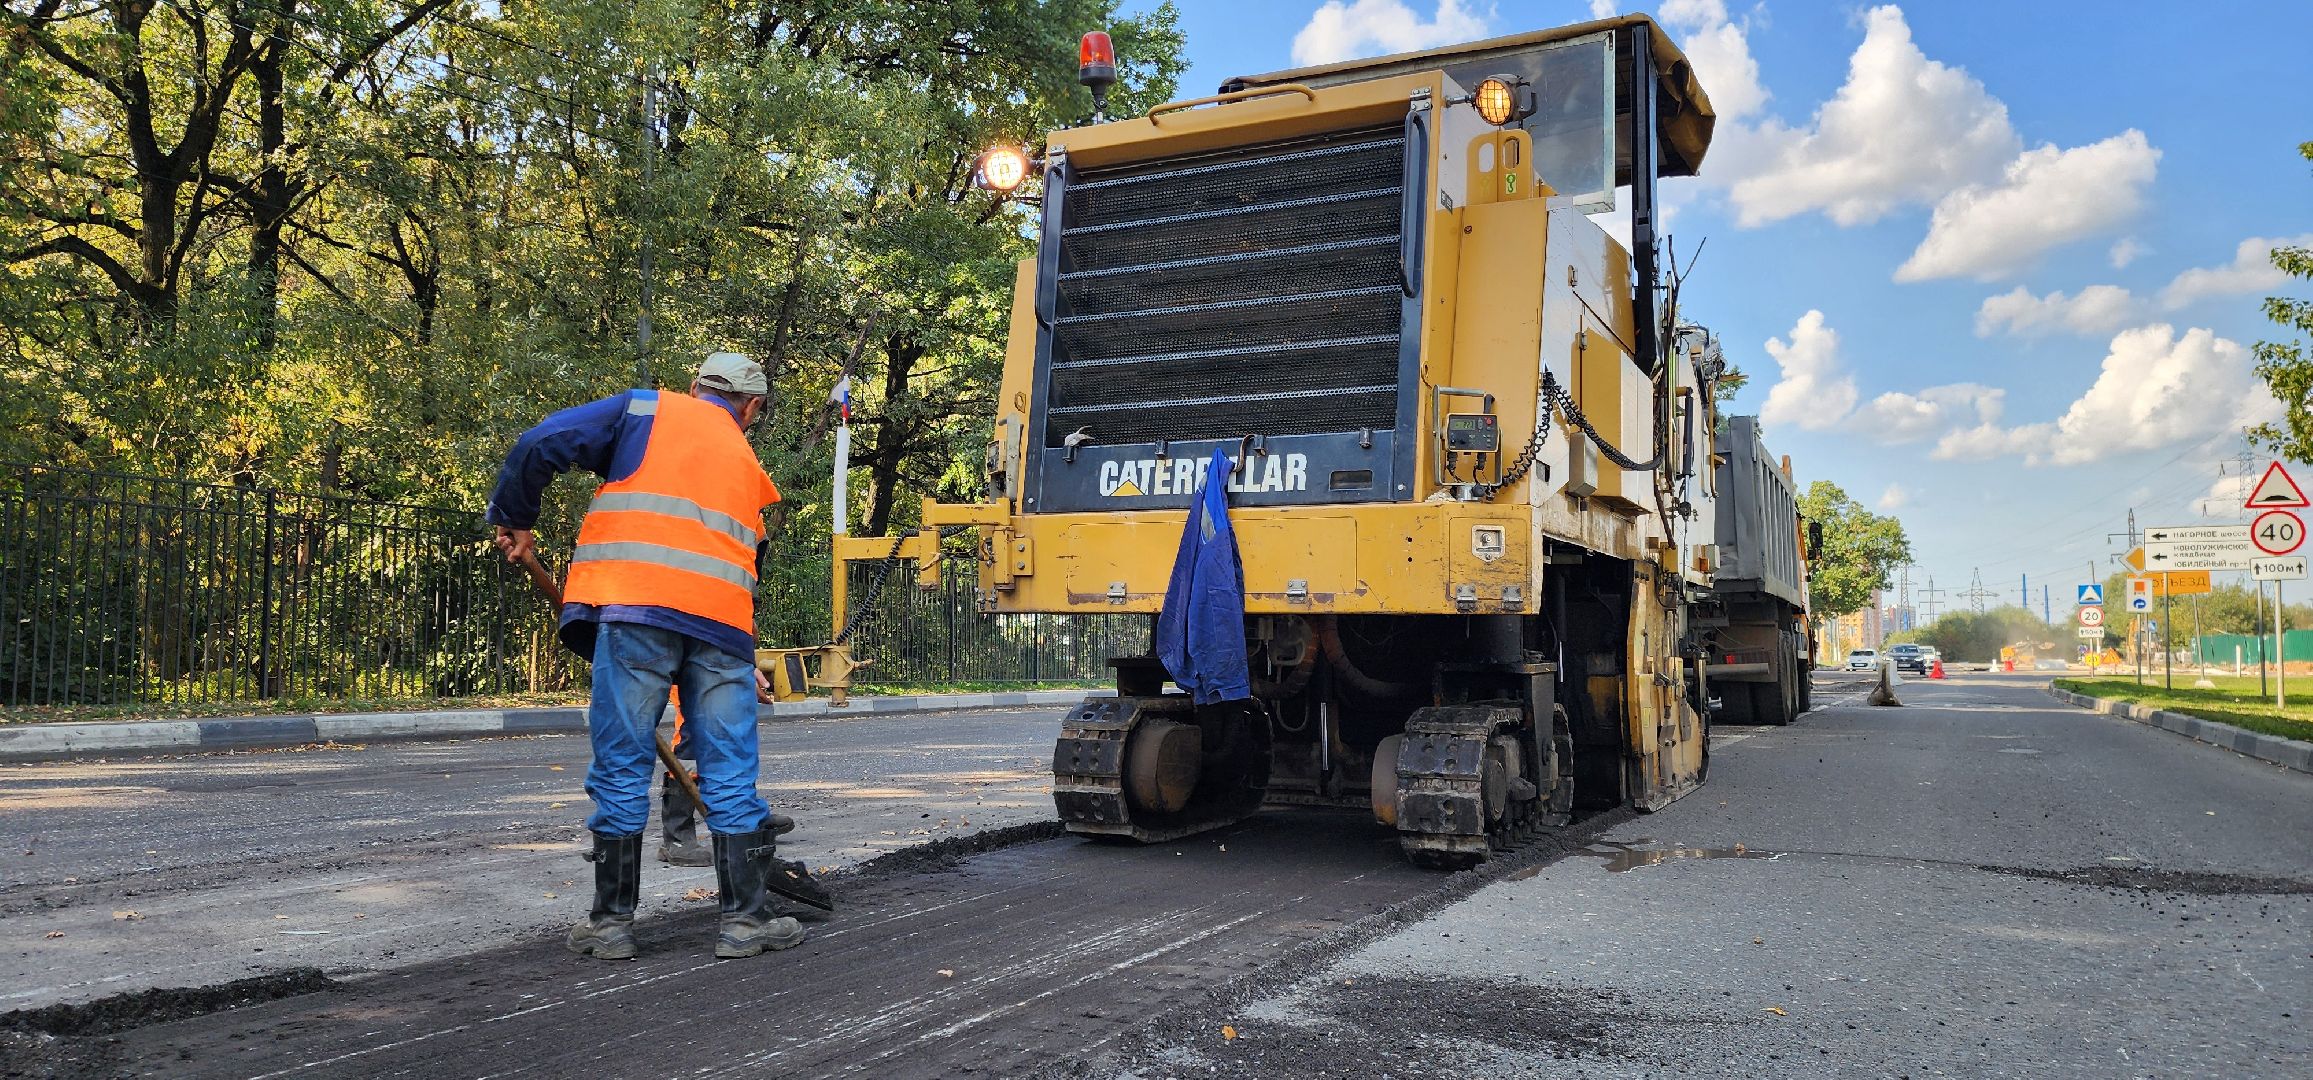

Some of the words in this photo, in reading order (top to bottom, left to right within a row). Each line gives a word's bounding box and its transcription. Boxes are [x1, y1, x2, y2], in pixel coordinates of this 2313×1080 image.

[1100, 453, 1308, 497] CATERPLLAR
[2173, 530, 2217, 538] НАГОРНОЕ
[2260, 523, 2294, 541] 40
[2173, 543, 2249, 551] НОВОЛУЖИНСКОЕ
[2174, 559, 2227, 568] ЮБИЛЕЙНЫЙ
[2264, 563, 2294, 573] 100м
[2085, 612, 2098, 621] 20
